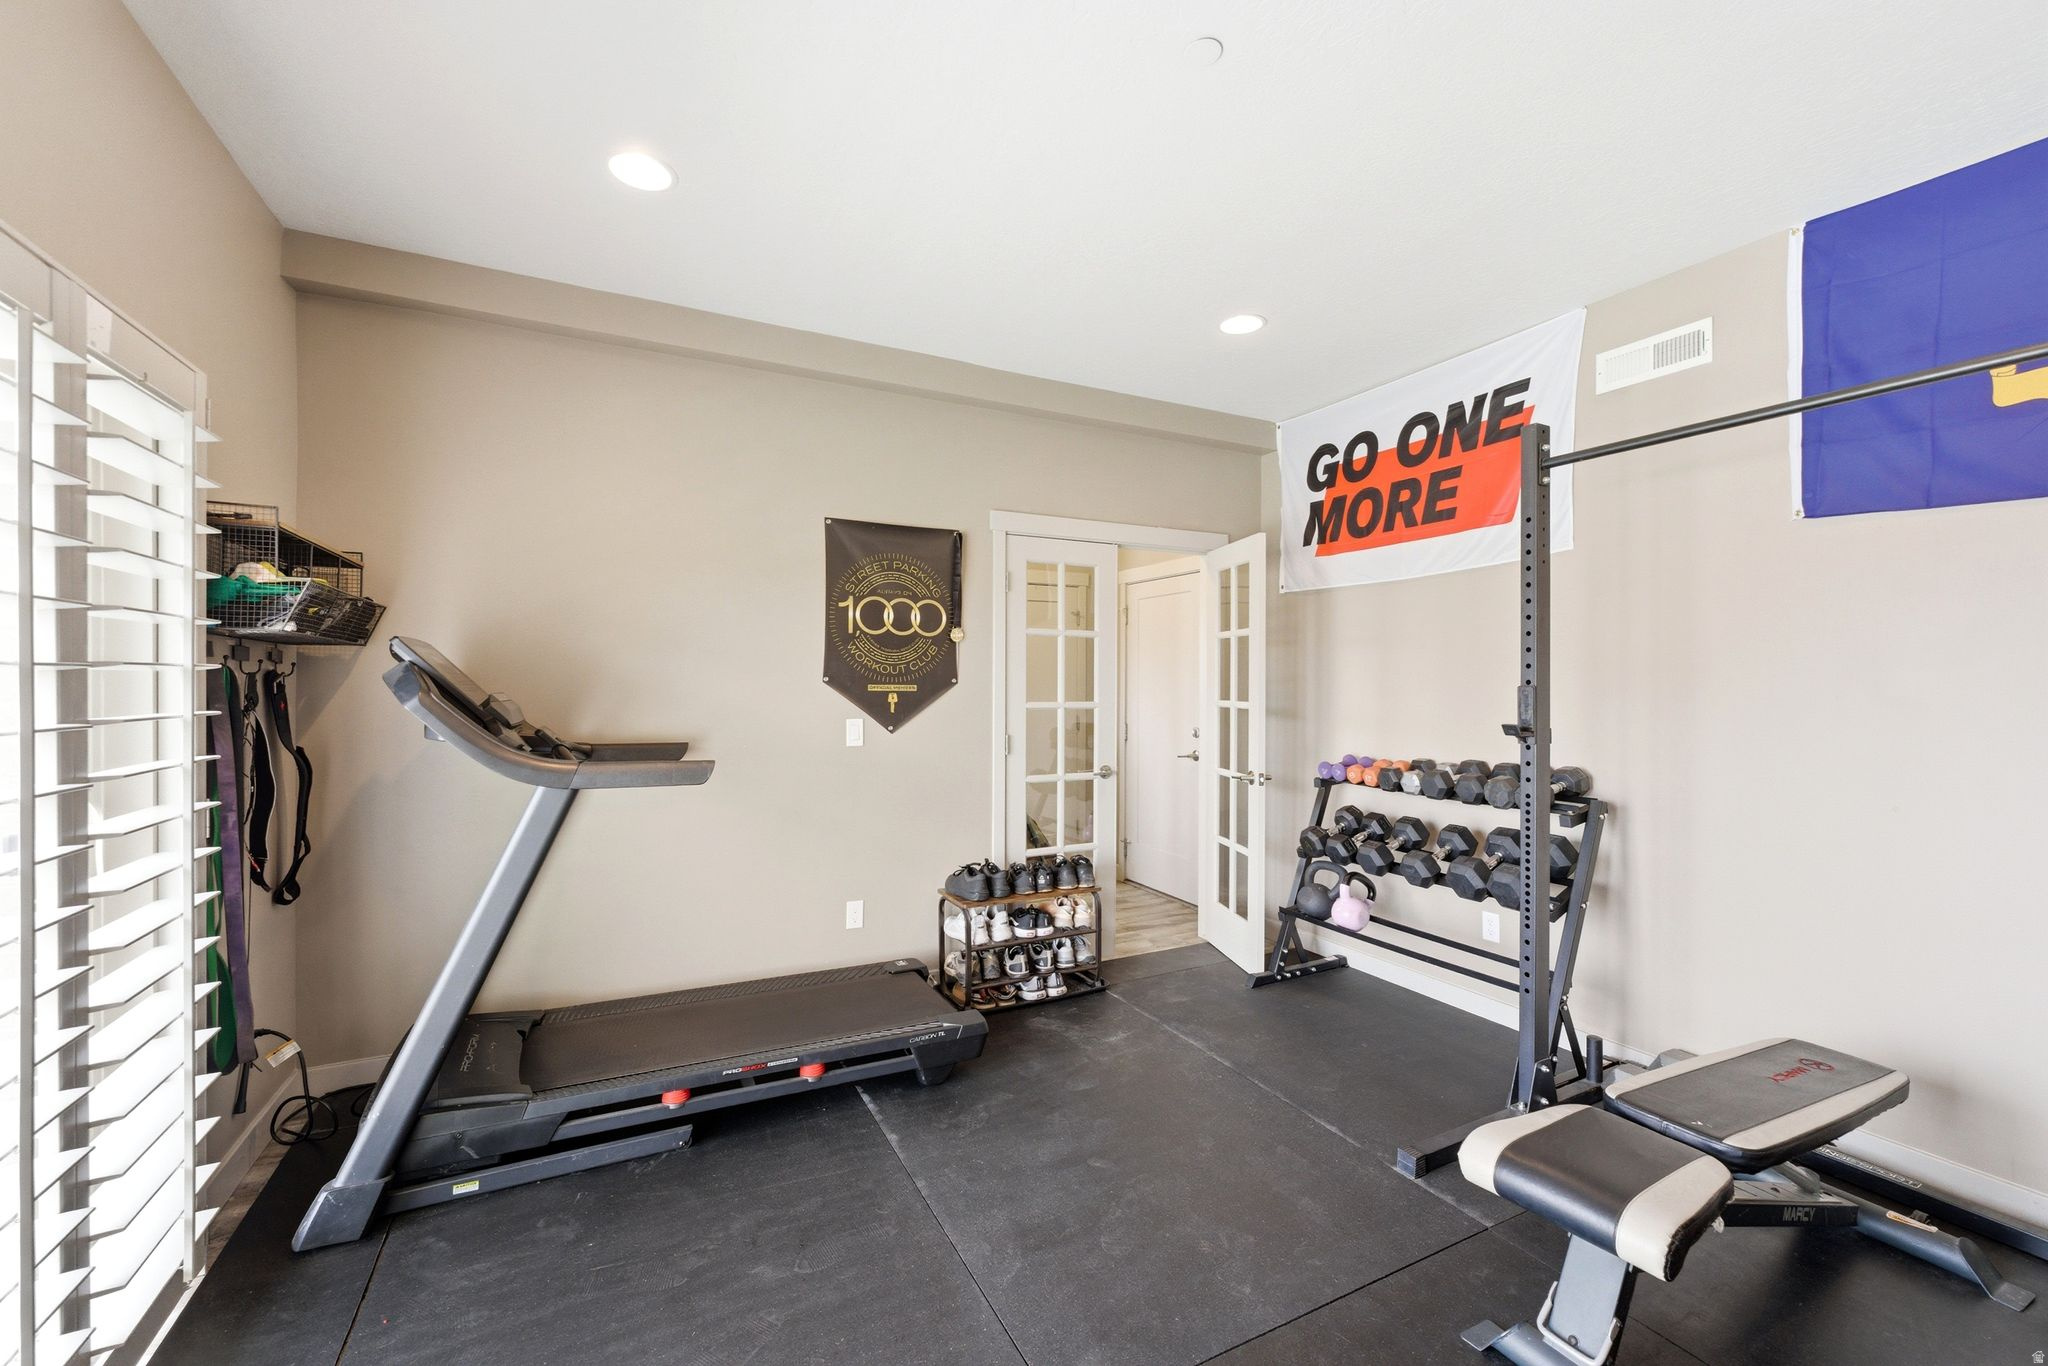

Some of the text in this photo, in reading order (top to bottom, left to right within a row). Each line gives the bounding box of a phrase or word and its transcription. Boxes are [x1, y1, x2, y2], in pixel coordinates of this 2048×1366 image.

[1307, 377, 1531, 492] GO ONE
[1303, 465, 1463, 547] MORE
[845, 561, 942, 598] STREET PARKING
[847, 641, 907, 675] WORKOUT
[909, 645, 938, 671] CLUB
[910, 1032, 937, 1043] CARBON
[1783, 1206, 1816, 1222] MARCY
